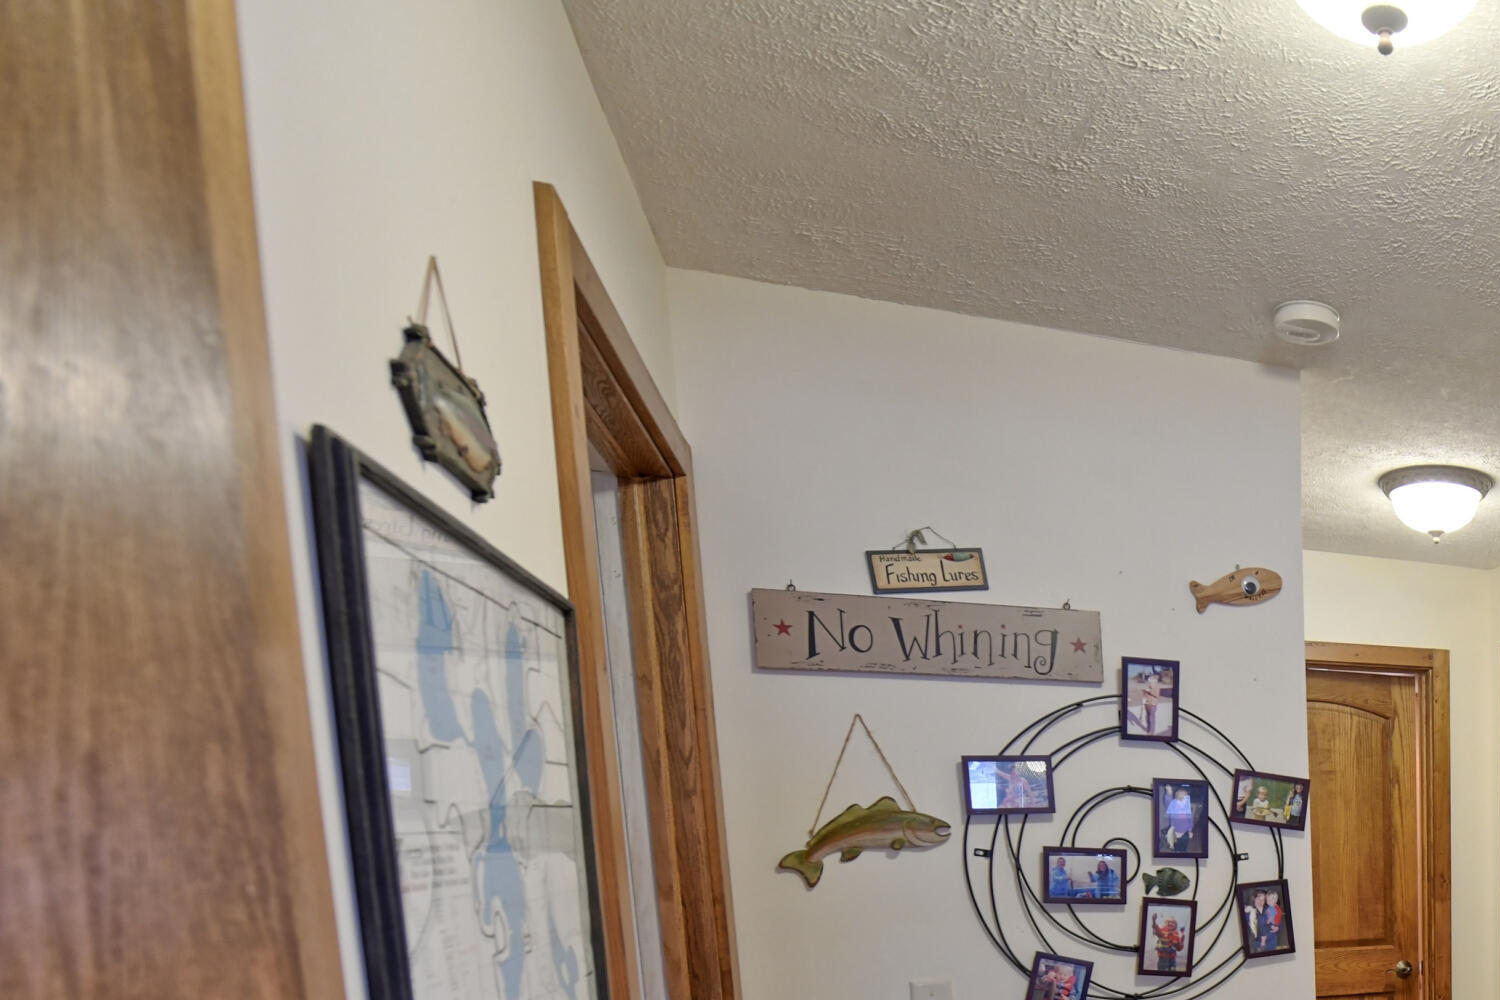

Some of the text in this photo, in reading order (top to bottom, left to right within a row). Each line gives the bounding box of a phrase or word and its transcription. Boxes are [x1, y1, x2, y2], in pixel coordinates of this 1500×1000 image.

[885, 559, 979, 586] Fishing Lures
[806, 608, 1059, 675] No Whining
